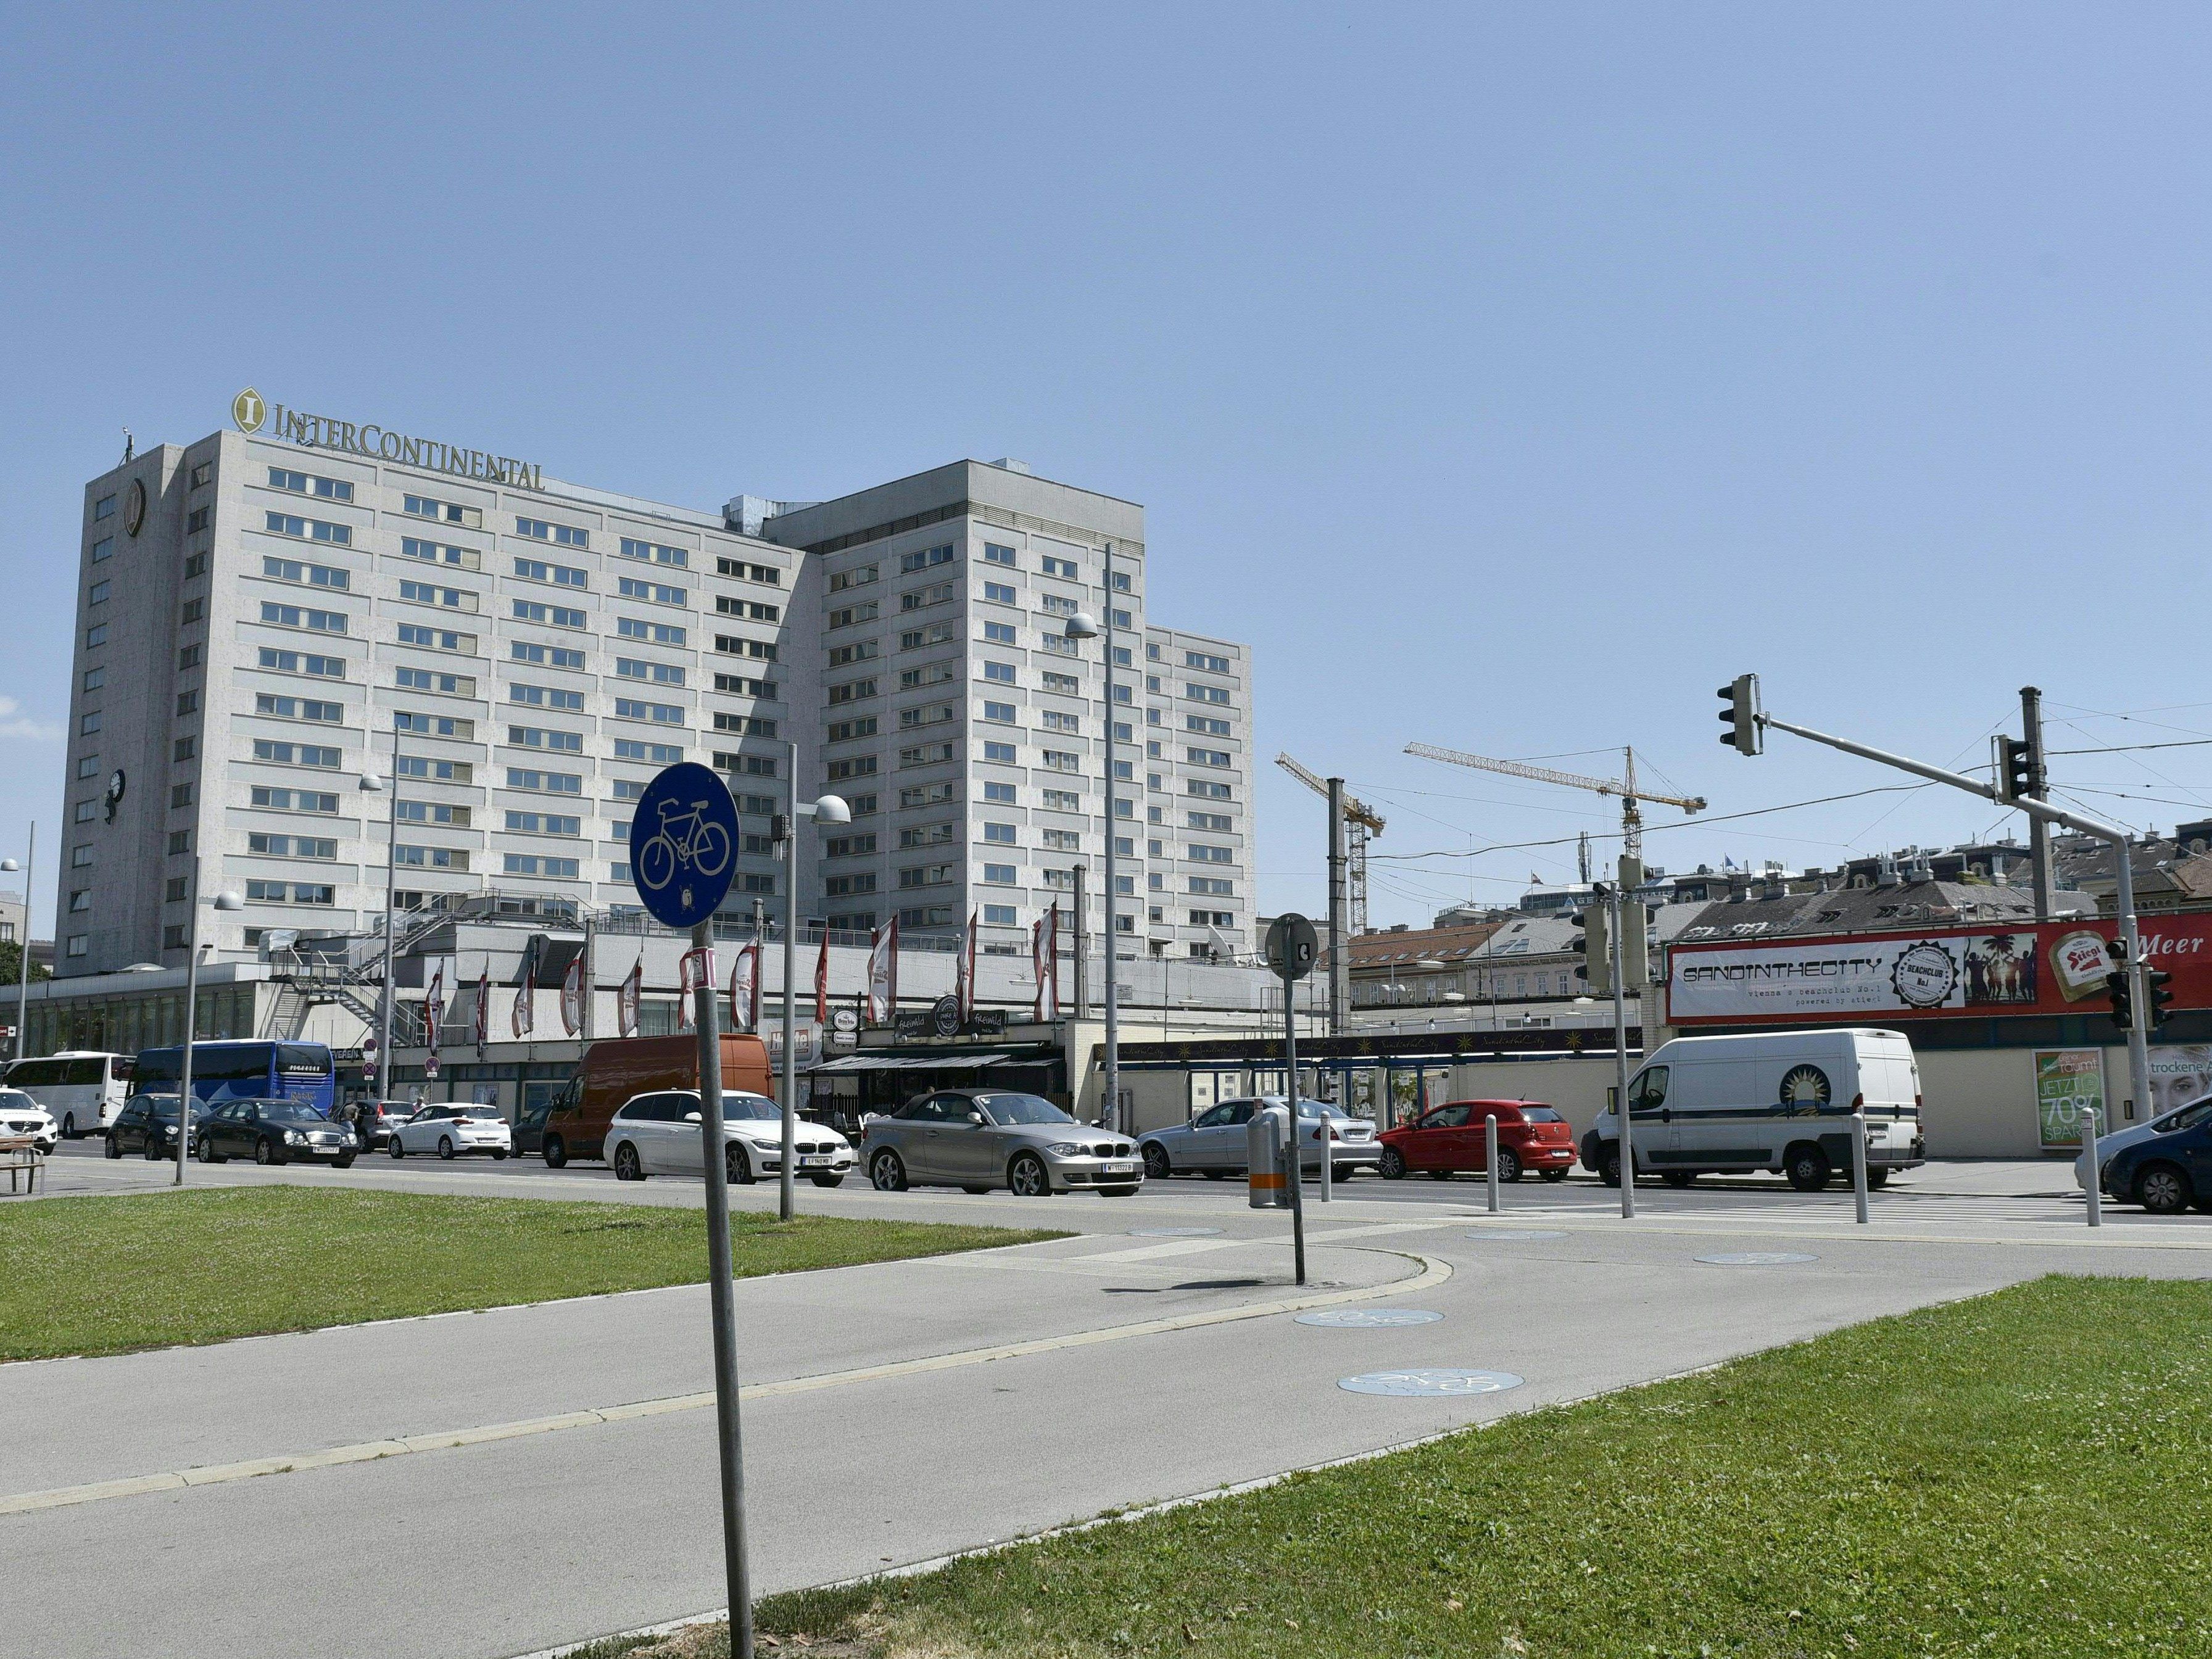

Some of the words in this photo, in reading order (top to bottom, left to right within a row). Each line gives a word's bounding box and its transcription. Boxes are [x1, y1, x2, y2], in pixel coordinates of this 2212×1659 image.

[2139, 934, 2203, 956] Meer
[2066, 945, 2102, 972] Stiegl
[1683, 958, 1882, 982] SANDINTHECITY
[1907, 964, 1944, 978] BEACHCLUB
[1796, 998, 1831, 1007] powered
[2061, 1058, 2097, 1074] räumt
[2150, 1061, 2203, 1073] trockene
[2045, 1120, 2103, 1141] SPARN
